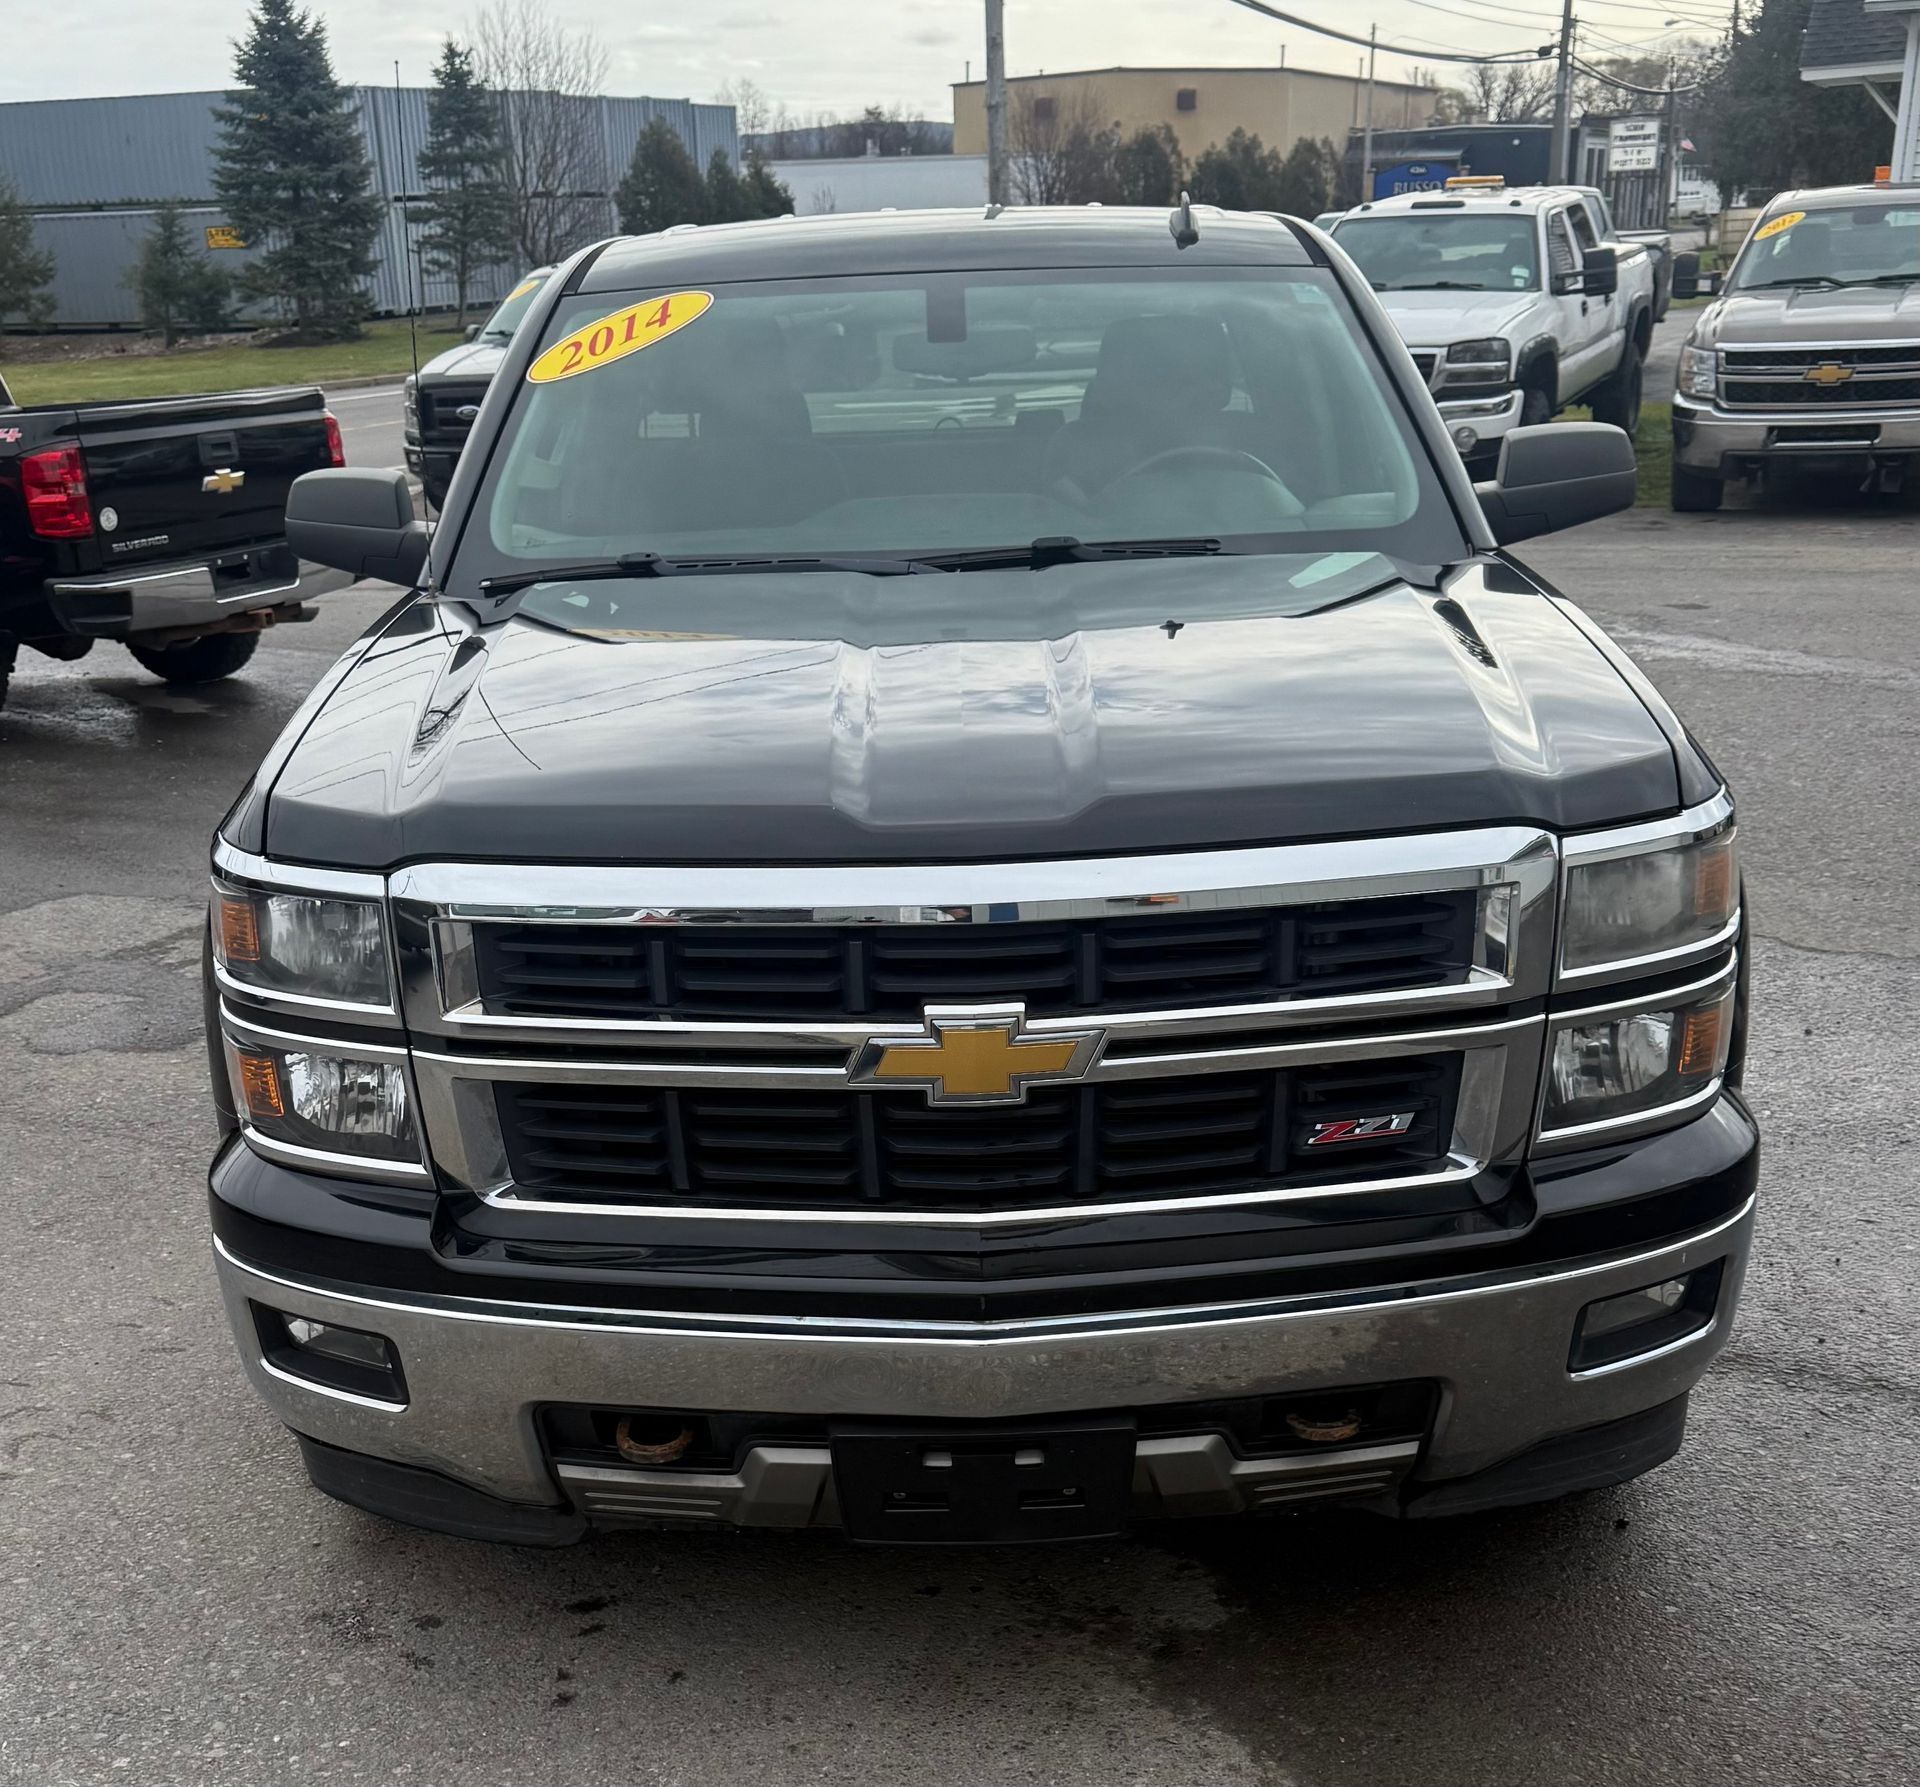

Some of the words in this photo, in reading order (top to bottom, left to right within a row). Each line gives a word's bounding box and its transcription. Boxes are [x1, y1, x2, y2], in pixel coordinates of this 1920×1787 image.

[559, 299, 672, 374] 2014
[112, 535, 169, 552] SILVERADO
[1307, 1111, 1415, 1144] Z71
